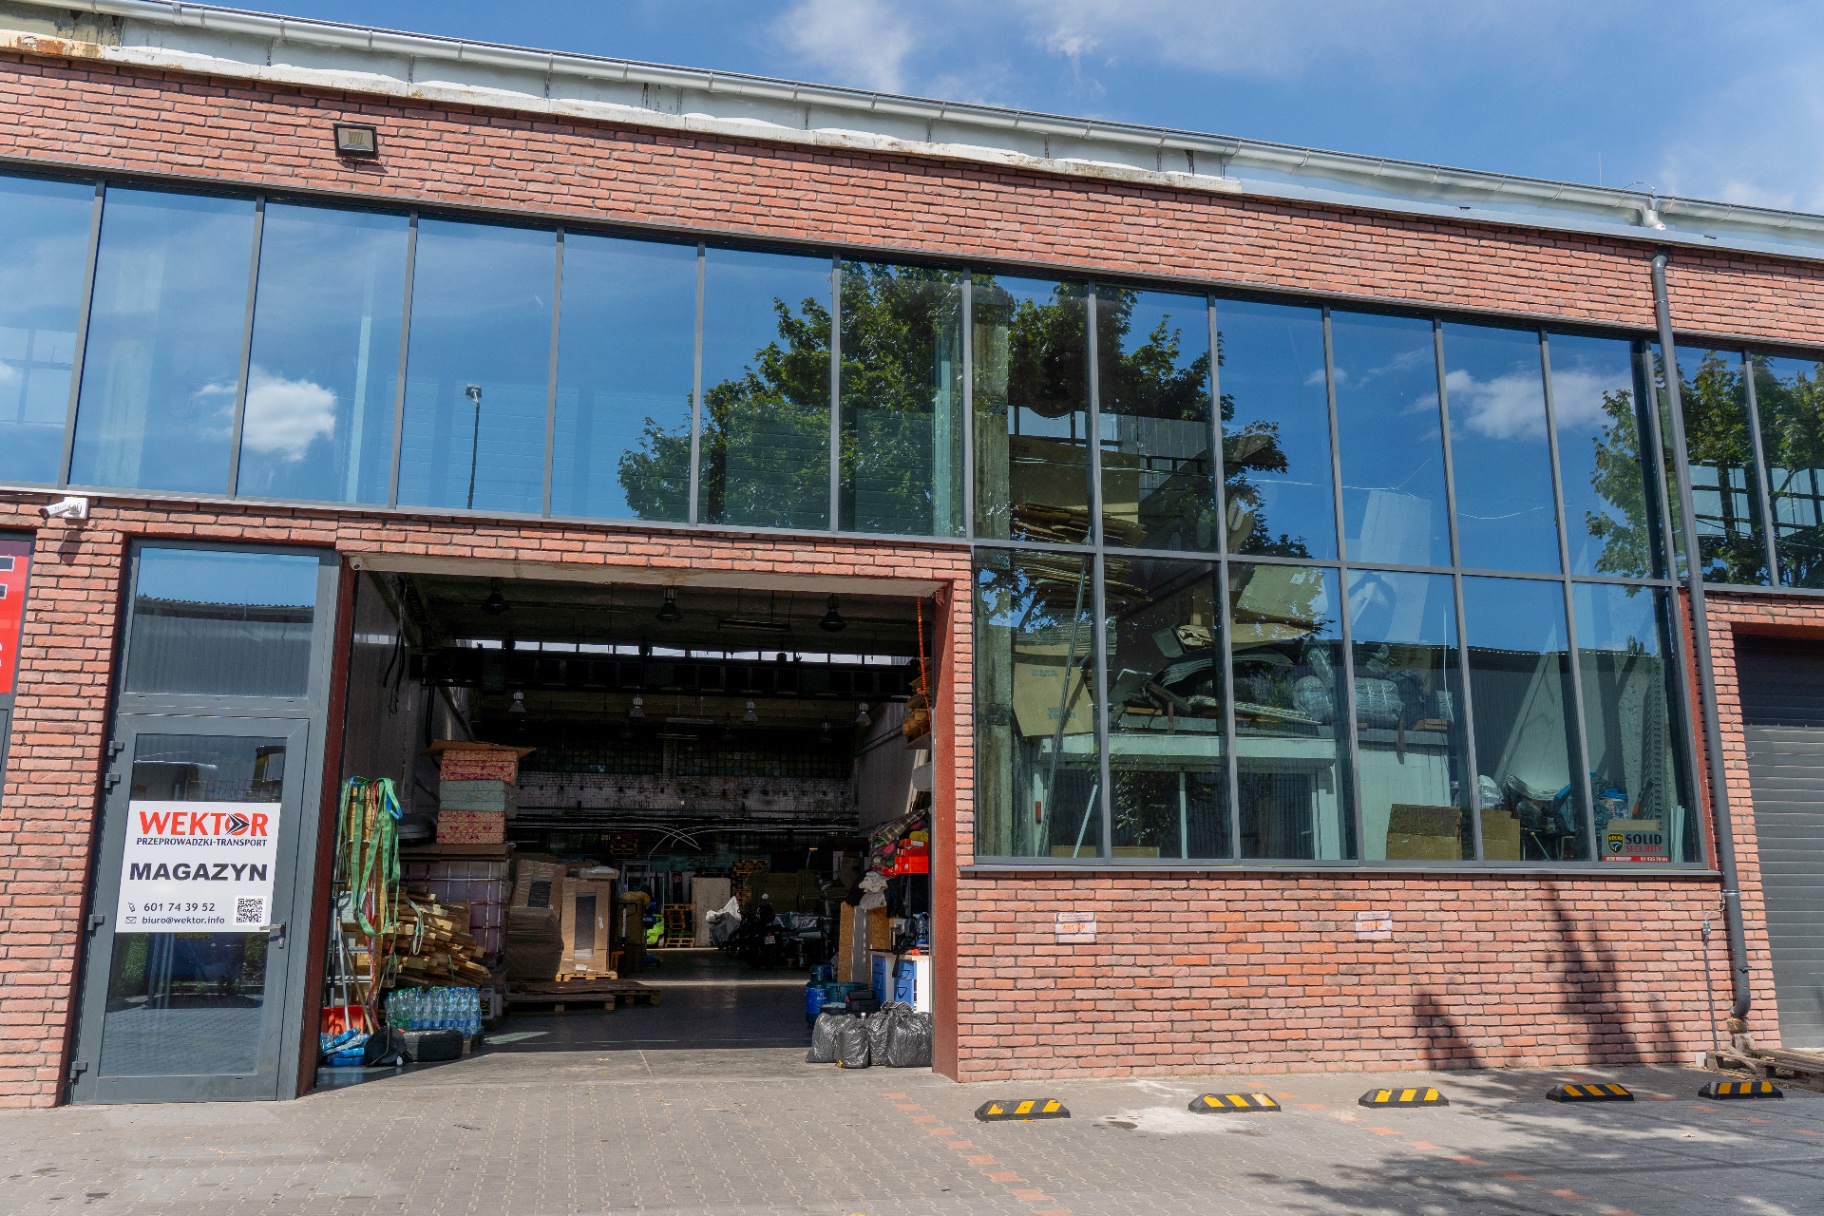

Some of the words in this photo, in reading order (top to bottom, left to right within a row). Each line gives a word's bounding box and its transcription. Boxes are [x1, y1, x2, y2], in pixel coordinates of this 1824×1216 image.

[139, 811, 269, 836] WEKTOR
[136, 837, 268, 847] PRZEPROWADZKI-TRANSPORT
[1625, 833, 1663, 844] SOLID
[1626, 844, 1663, 852] SECURITY
[129, 862, 268, 882] MAGAZYN
[143, 902, 163, 912] 601
[168, 902, 181, 911] 74
[185, 902, 198, 912] 39
[202, 902, 215, 912] 52
[142, 915, 225, 926] biuro@wektor.info
